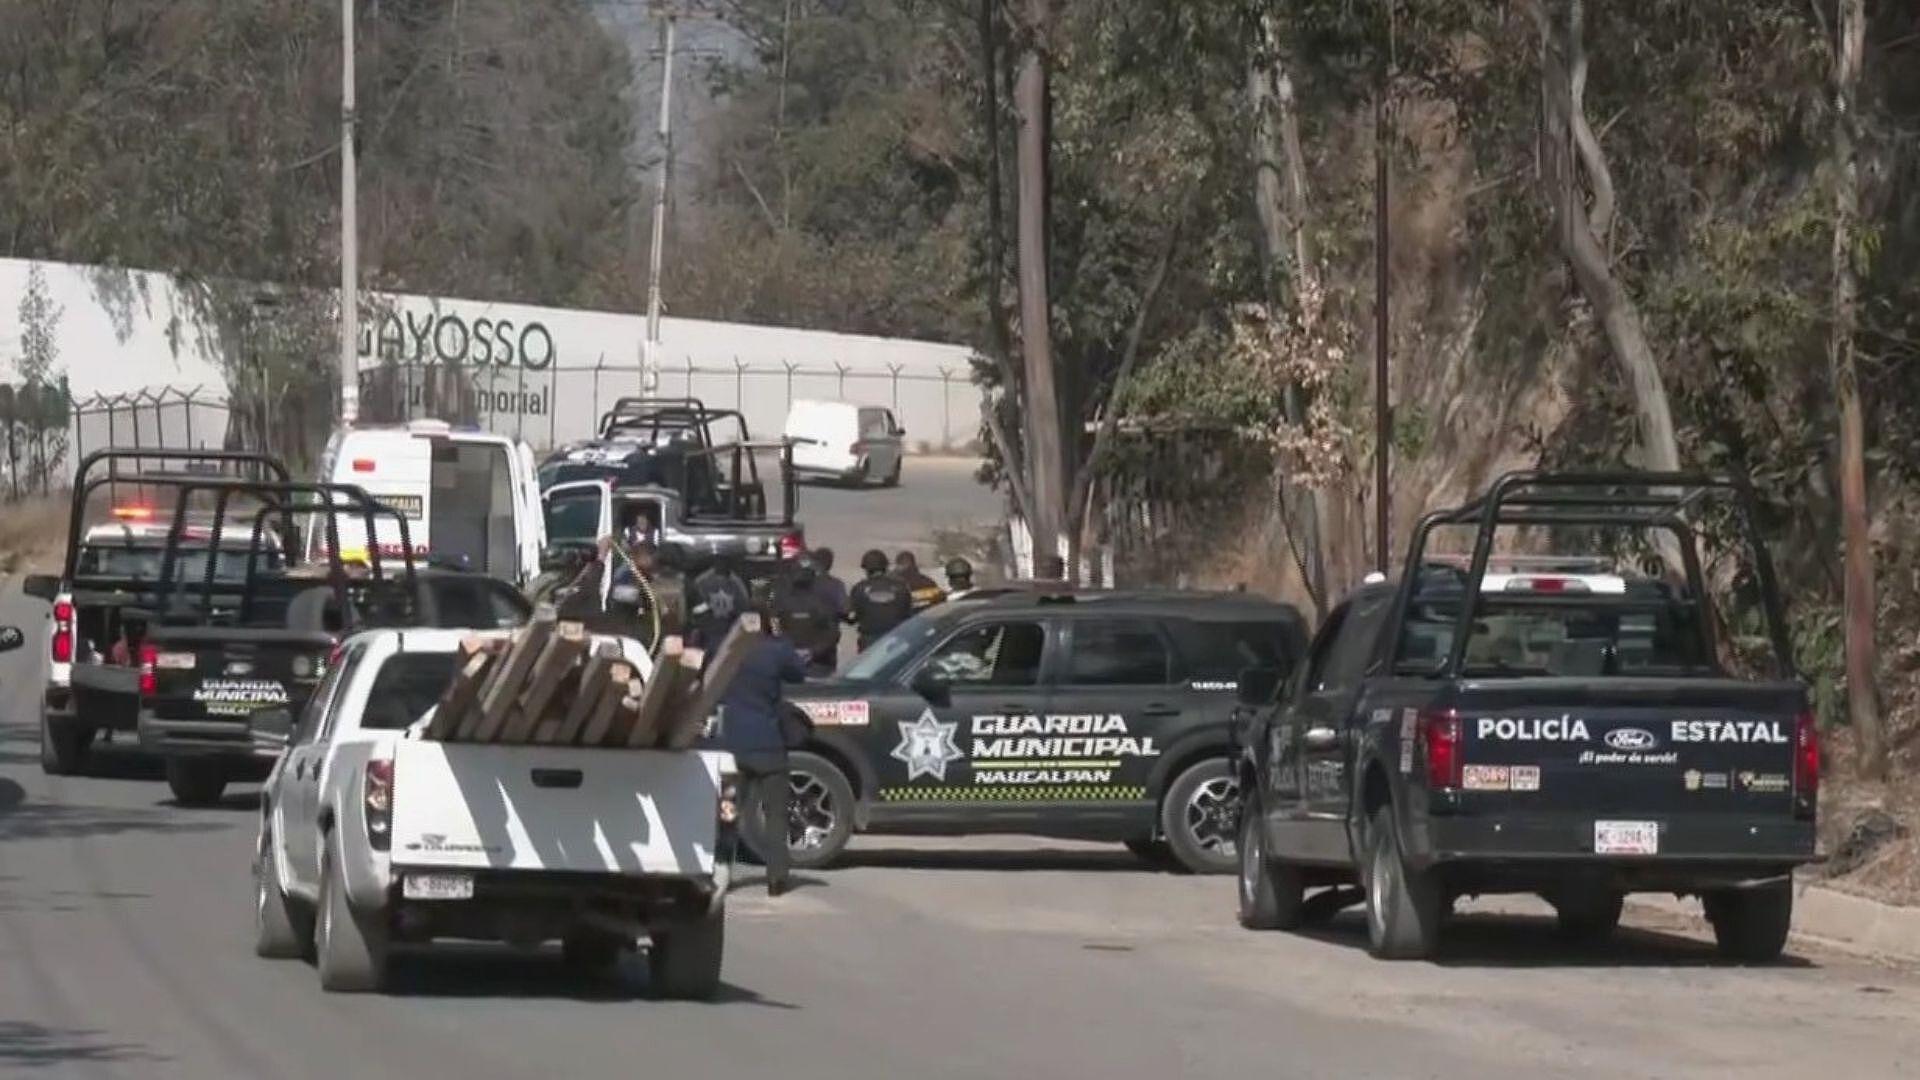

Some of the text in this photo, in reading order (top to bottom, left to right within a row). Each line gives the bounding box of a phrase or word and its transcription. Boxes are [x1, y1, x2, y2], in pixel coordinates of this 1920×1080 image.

[477, 385, 548, 415] morial
[202, 679, 284, 690] GUARDIA
[192, 690, 289, 702] MUNICIPAL
[971, 714, 1127, 735] GUARDIA
[1477, 714, 1590, 741] POLICÍA
[1671, 720, 1788, 743] ESTATAL
[971, 737, 1160, 758] MUNICIPAL
[1609, 730, 1649, 748] Ford
[1596, 751, 1626, 765] poder
[1628, 752, 1642, 763] de
[975, 769, 1112, 785] NAUCALPAN
